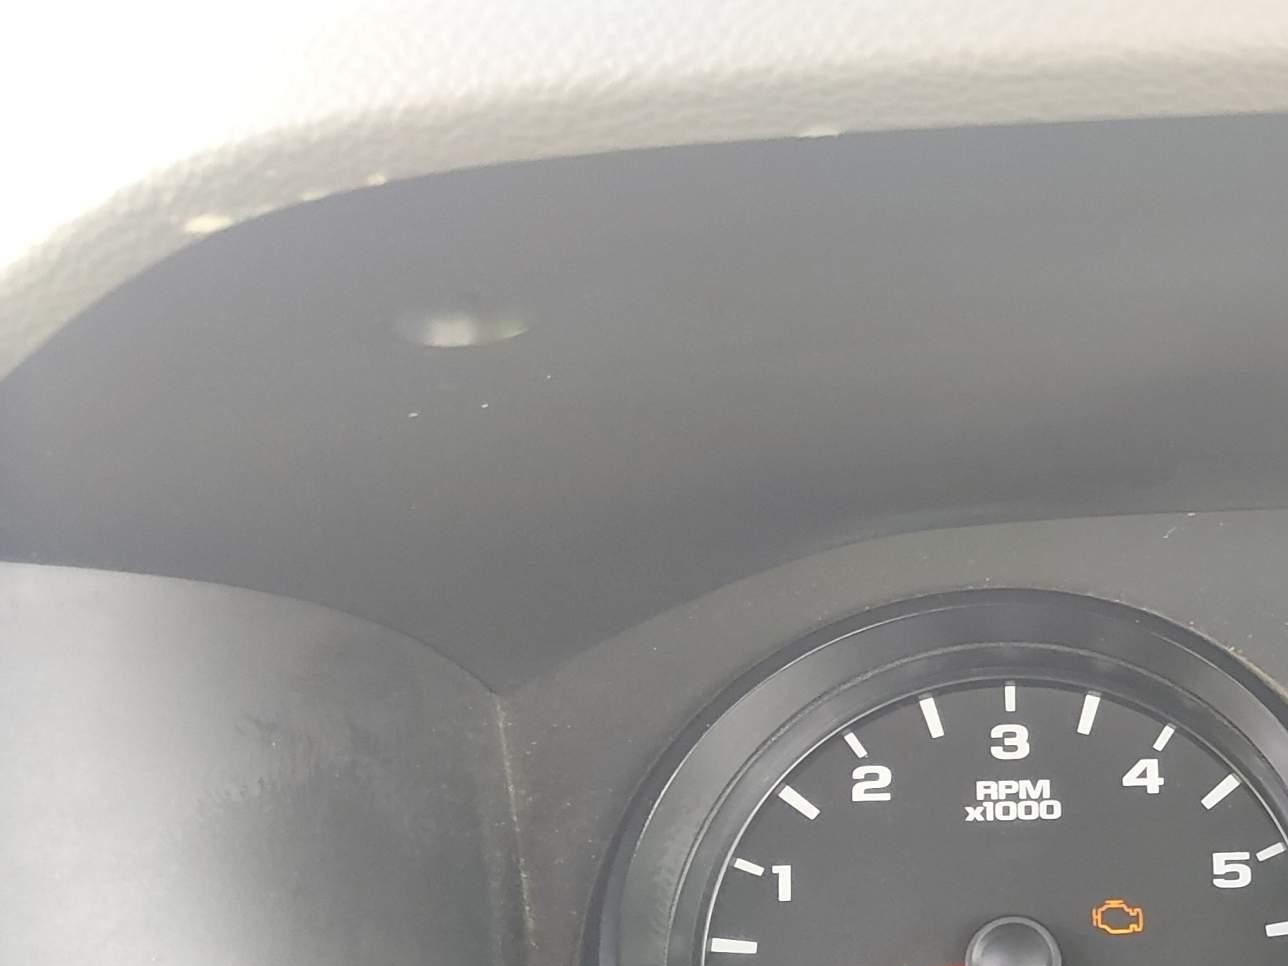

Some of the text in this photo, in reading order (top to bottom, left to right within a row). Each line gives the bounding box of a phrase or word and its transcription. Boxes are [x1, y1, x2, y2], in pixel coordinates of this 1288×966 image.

[990, 723, 1030, 760] 3
[851, 765, 892, 802] 2
[975, 779, 1051, 800] RPM
[1122, 758, 1165, 794] 4
[964, 800, 1062, 822] x1000
[771, 864, 792, 902] 1
[1212, 851, 1252, 889] 5
